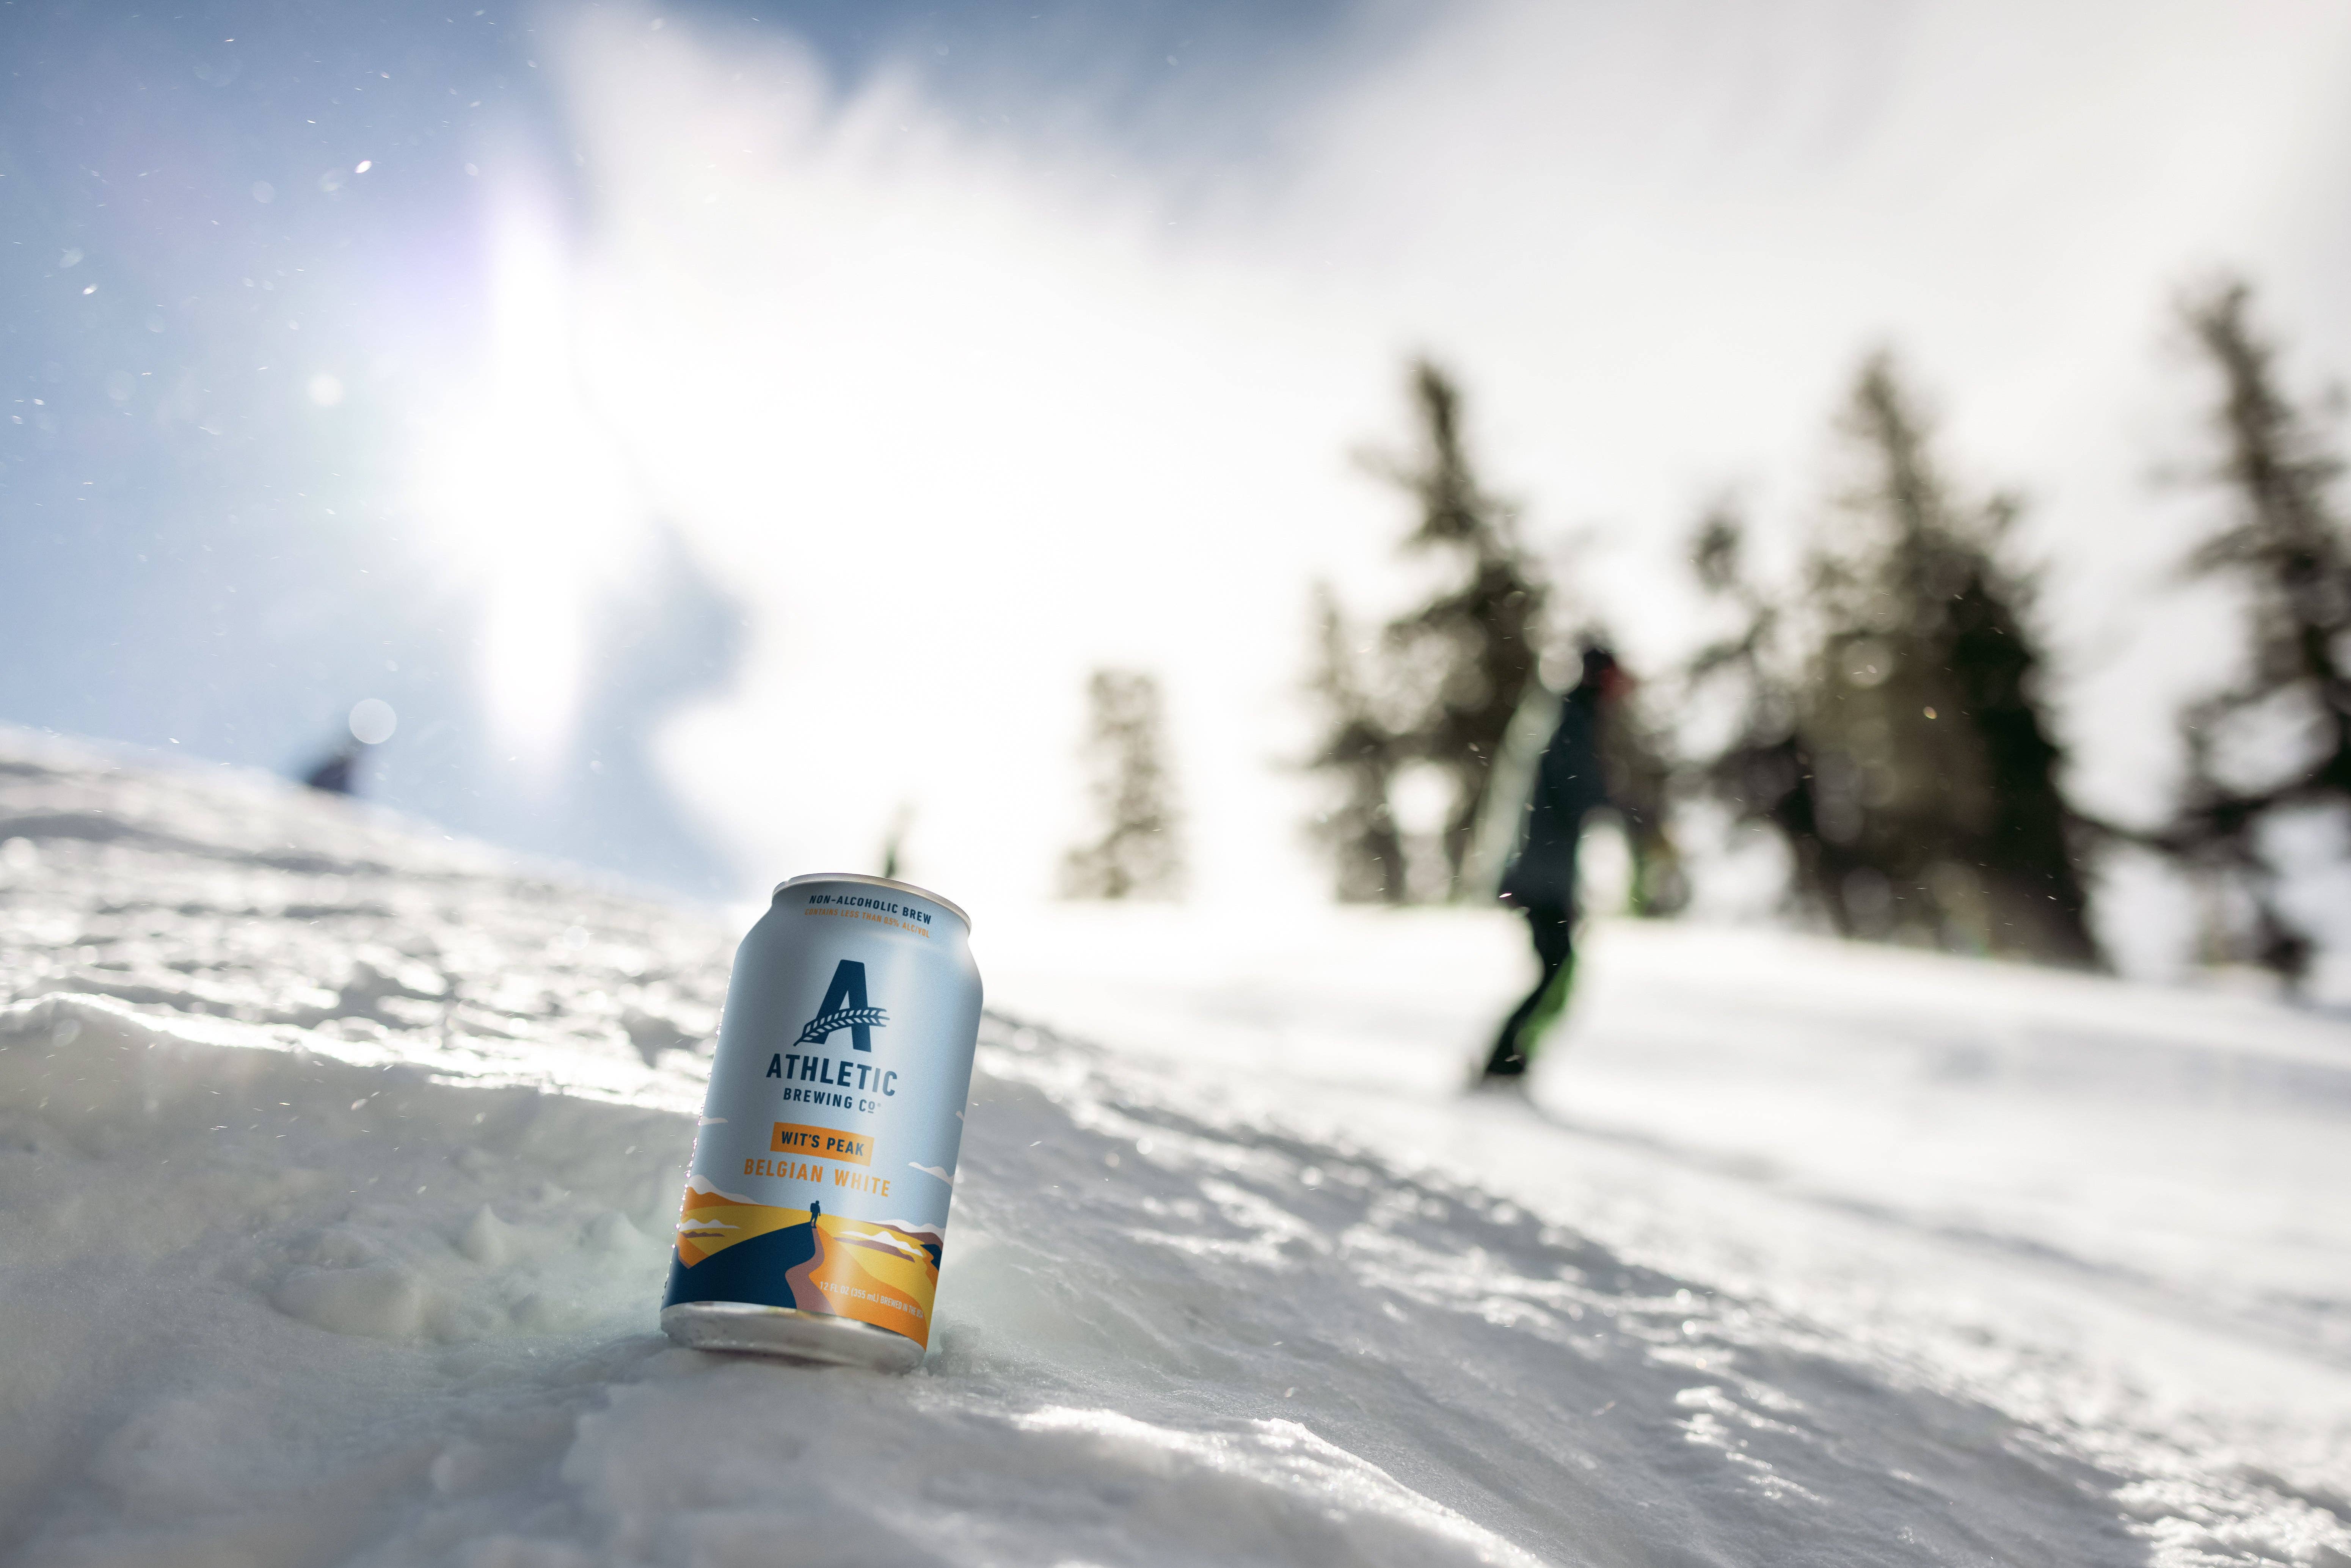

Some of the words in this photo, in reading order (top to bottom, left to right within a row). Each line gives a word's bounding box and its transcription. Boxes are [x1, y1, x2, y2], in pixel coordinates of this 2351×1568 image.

[809, 895, 898, 913] NON-ALCOHOLIC
[902, 907, 931, 924] BREW
[841, 909, 860, 918] LESS
[862, 912, 882, 923] THAN
[902, 922, 930, 939] ALC/VOL
[799, 959, 874, 1053] A
[766, 1053, 898, 1096] ATHLETIC
[783, 1088, 852, 1109] BREWING
[782, 1131, 820, 1148] WIT'S
[826, 1137, 865, 1156] PEAK
[744, 1158, 823, 1183] BELGIAN
[835, 1169, 890, 1197] WHITE
[820, 1281, 829, 1290] 12
[830, 1283, 838, 1293] FL
[840, 1285, 850, 1295] OZ
[851, 1287, 866, 1299] (355
[867, 1293, 879, 1303] mL)
[880, 1295, 902, 1310] BREWED
[902, 1303, 908, 1312] IN
